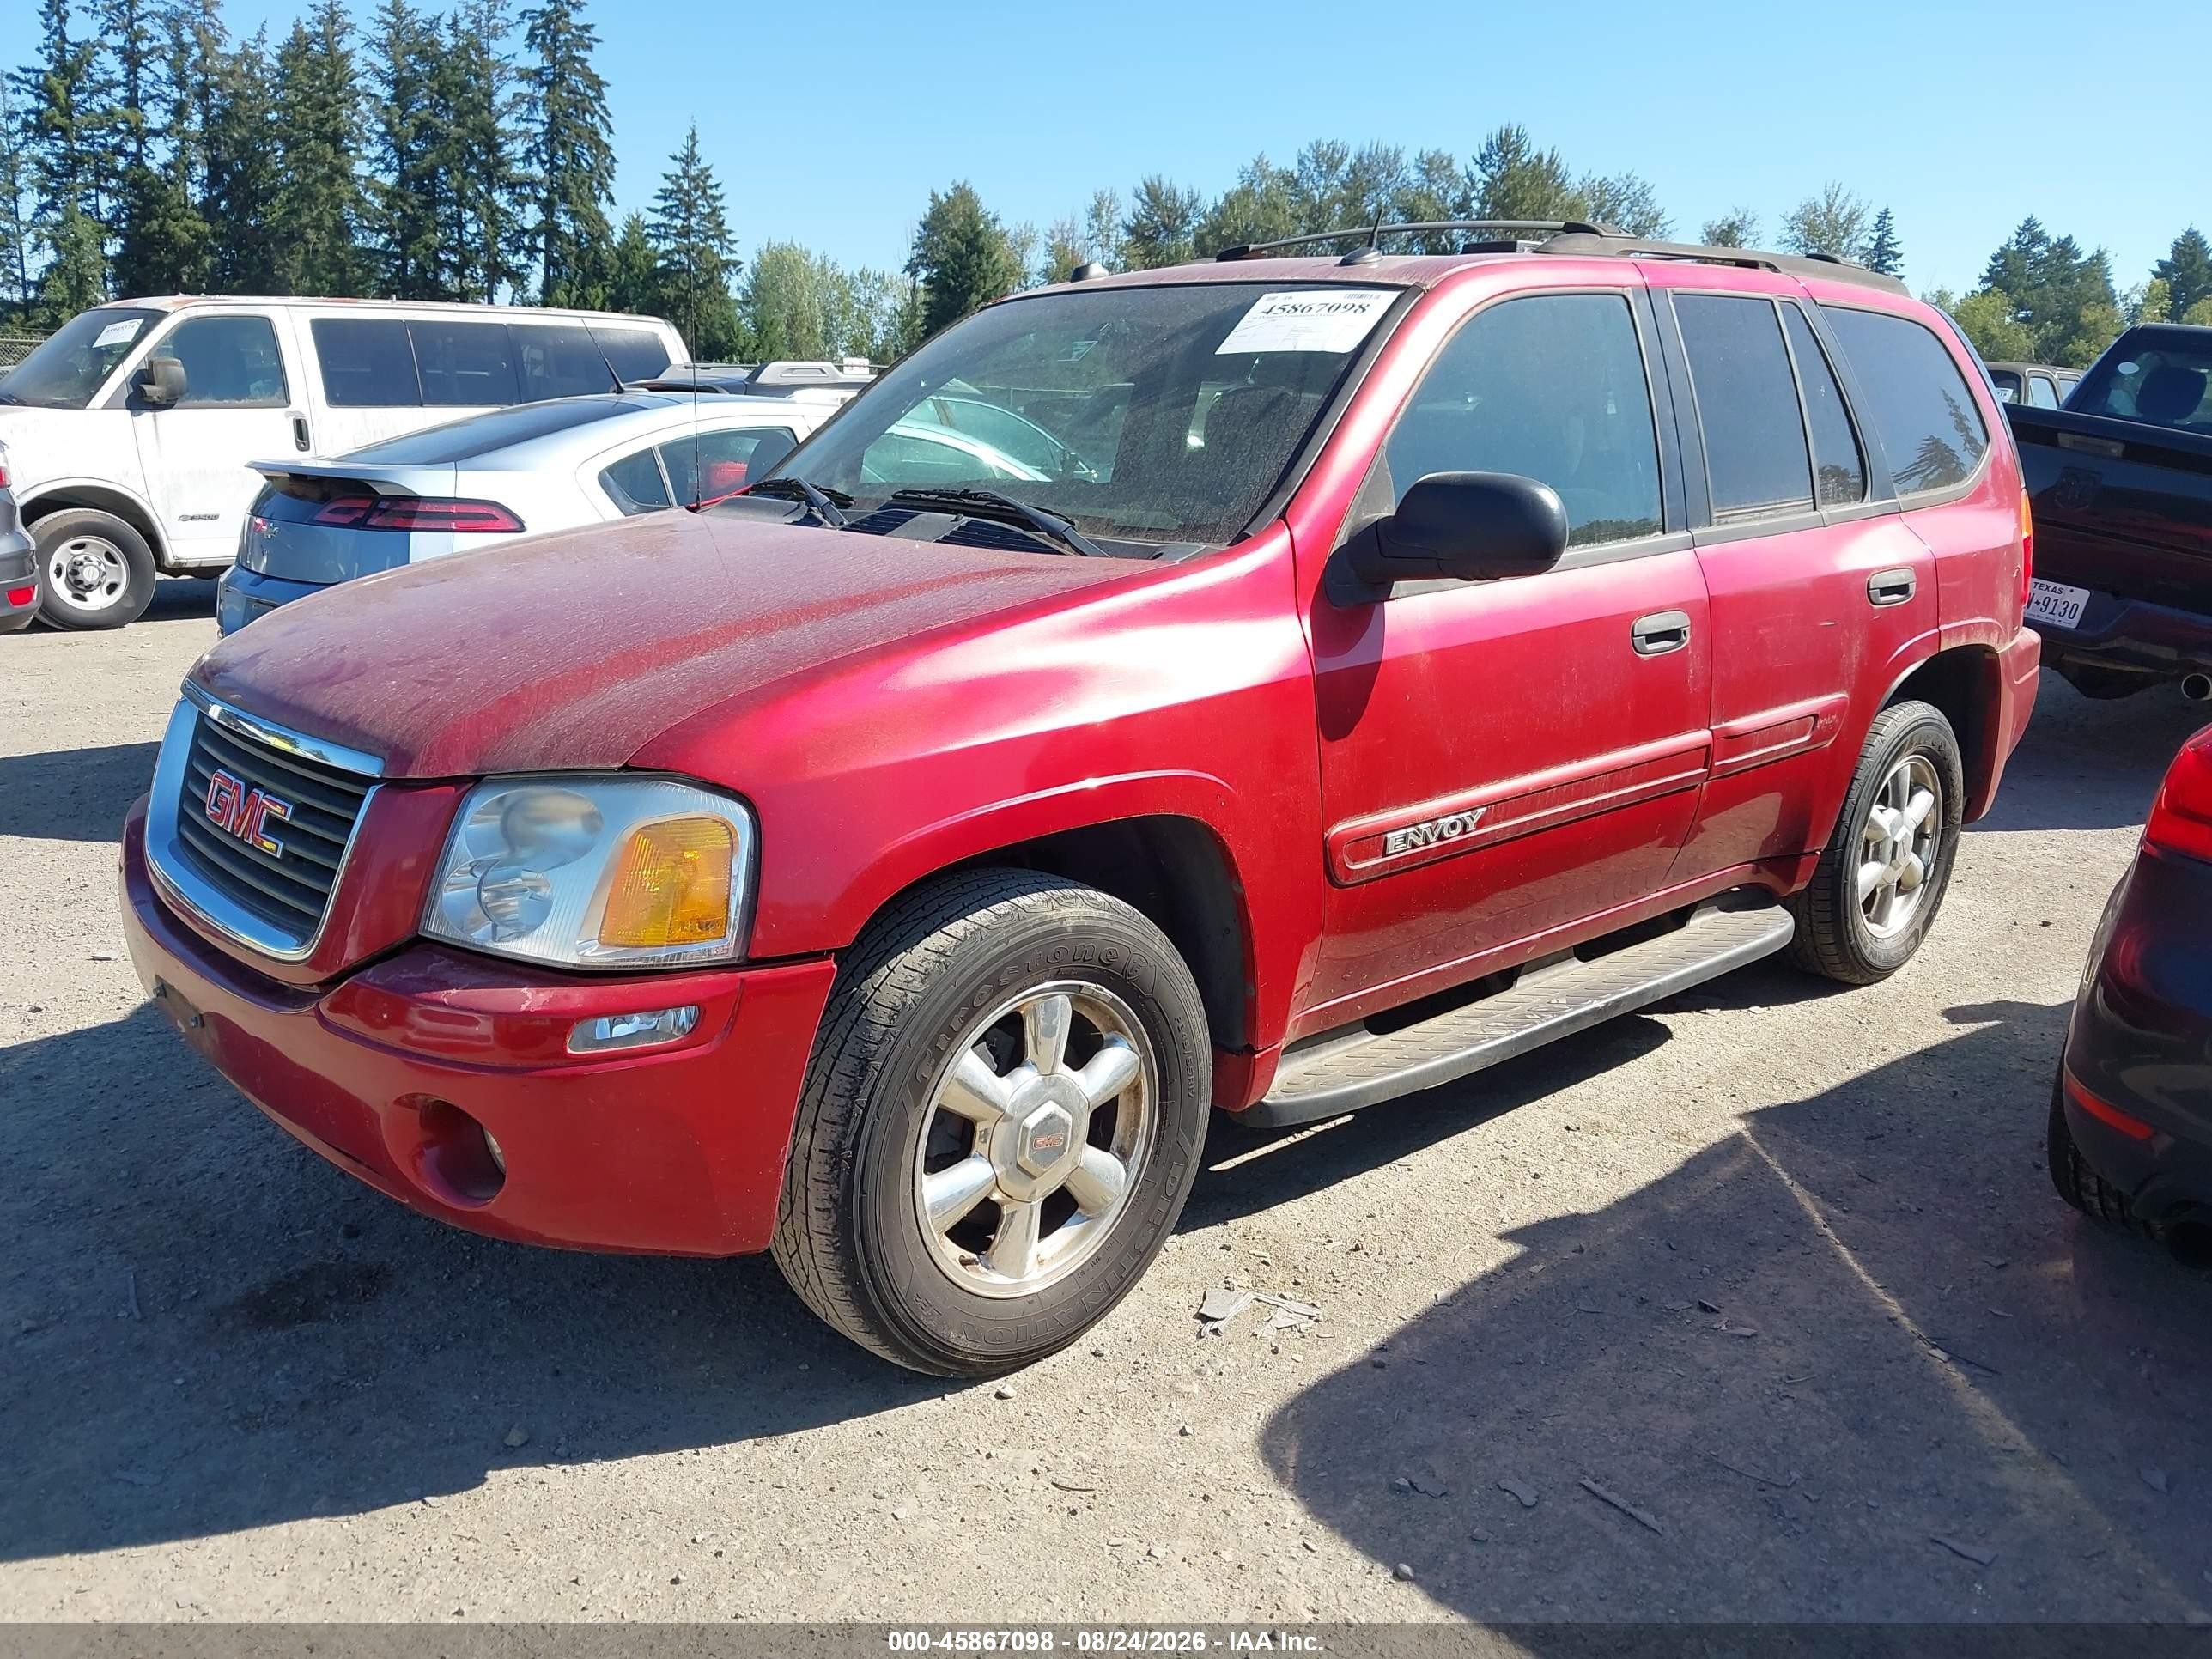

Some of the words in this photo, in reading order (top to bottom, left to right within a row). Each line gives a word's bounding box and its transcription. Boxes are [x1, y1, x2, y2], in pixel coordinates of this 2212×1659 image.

[1261, 302, 1370, 315] 45867098
[2033, 582, 2064, 594] TEXAS
[206, 769, 294, 860] GMC
[1385, 807, 1487, 855] ENVOY
[1033, 1133, 1065, 1150] GMC
